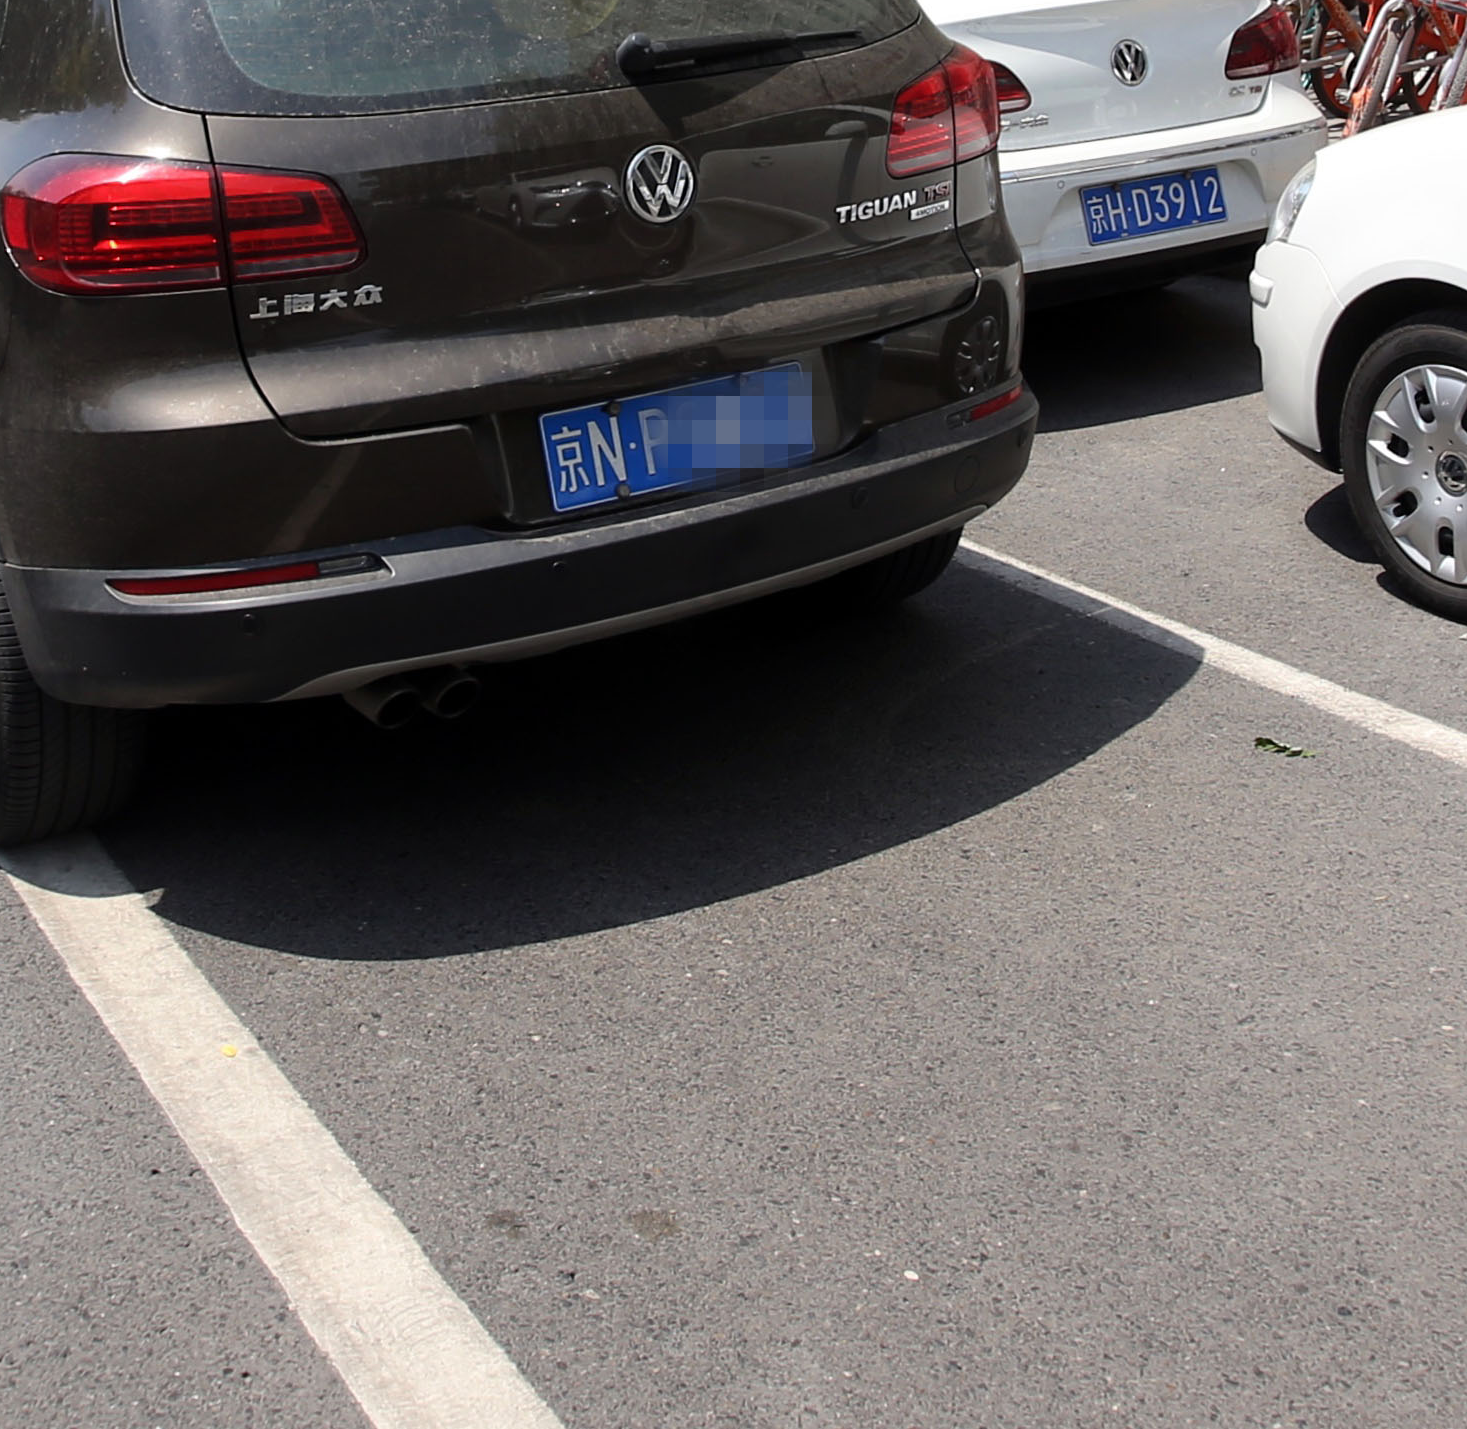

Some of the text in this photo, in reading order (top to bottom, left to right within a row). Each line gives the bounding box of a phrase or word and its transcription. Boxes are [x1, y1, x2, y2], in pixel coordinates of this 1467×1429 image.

[626, 144, 693, 223] VW
[836, 180, 952, 224] TIGUAN TSI
[249, 284, 383, 320] 上海大众
